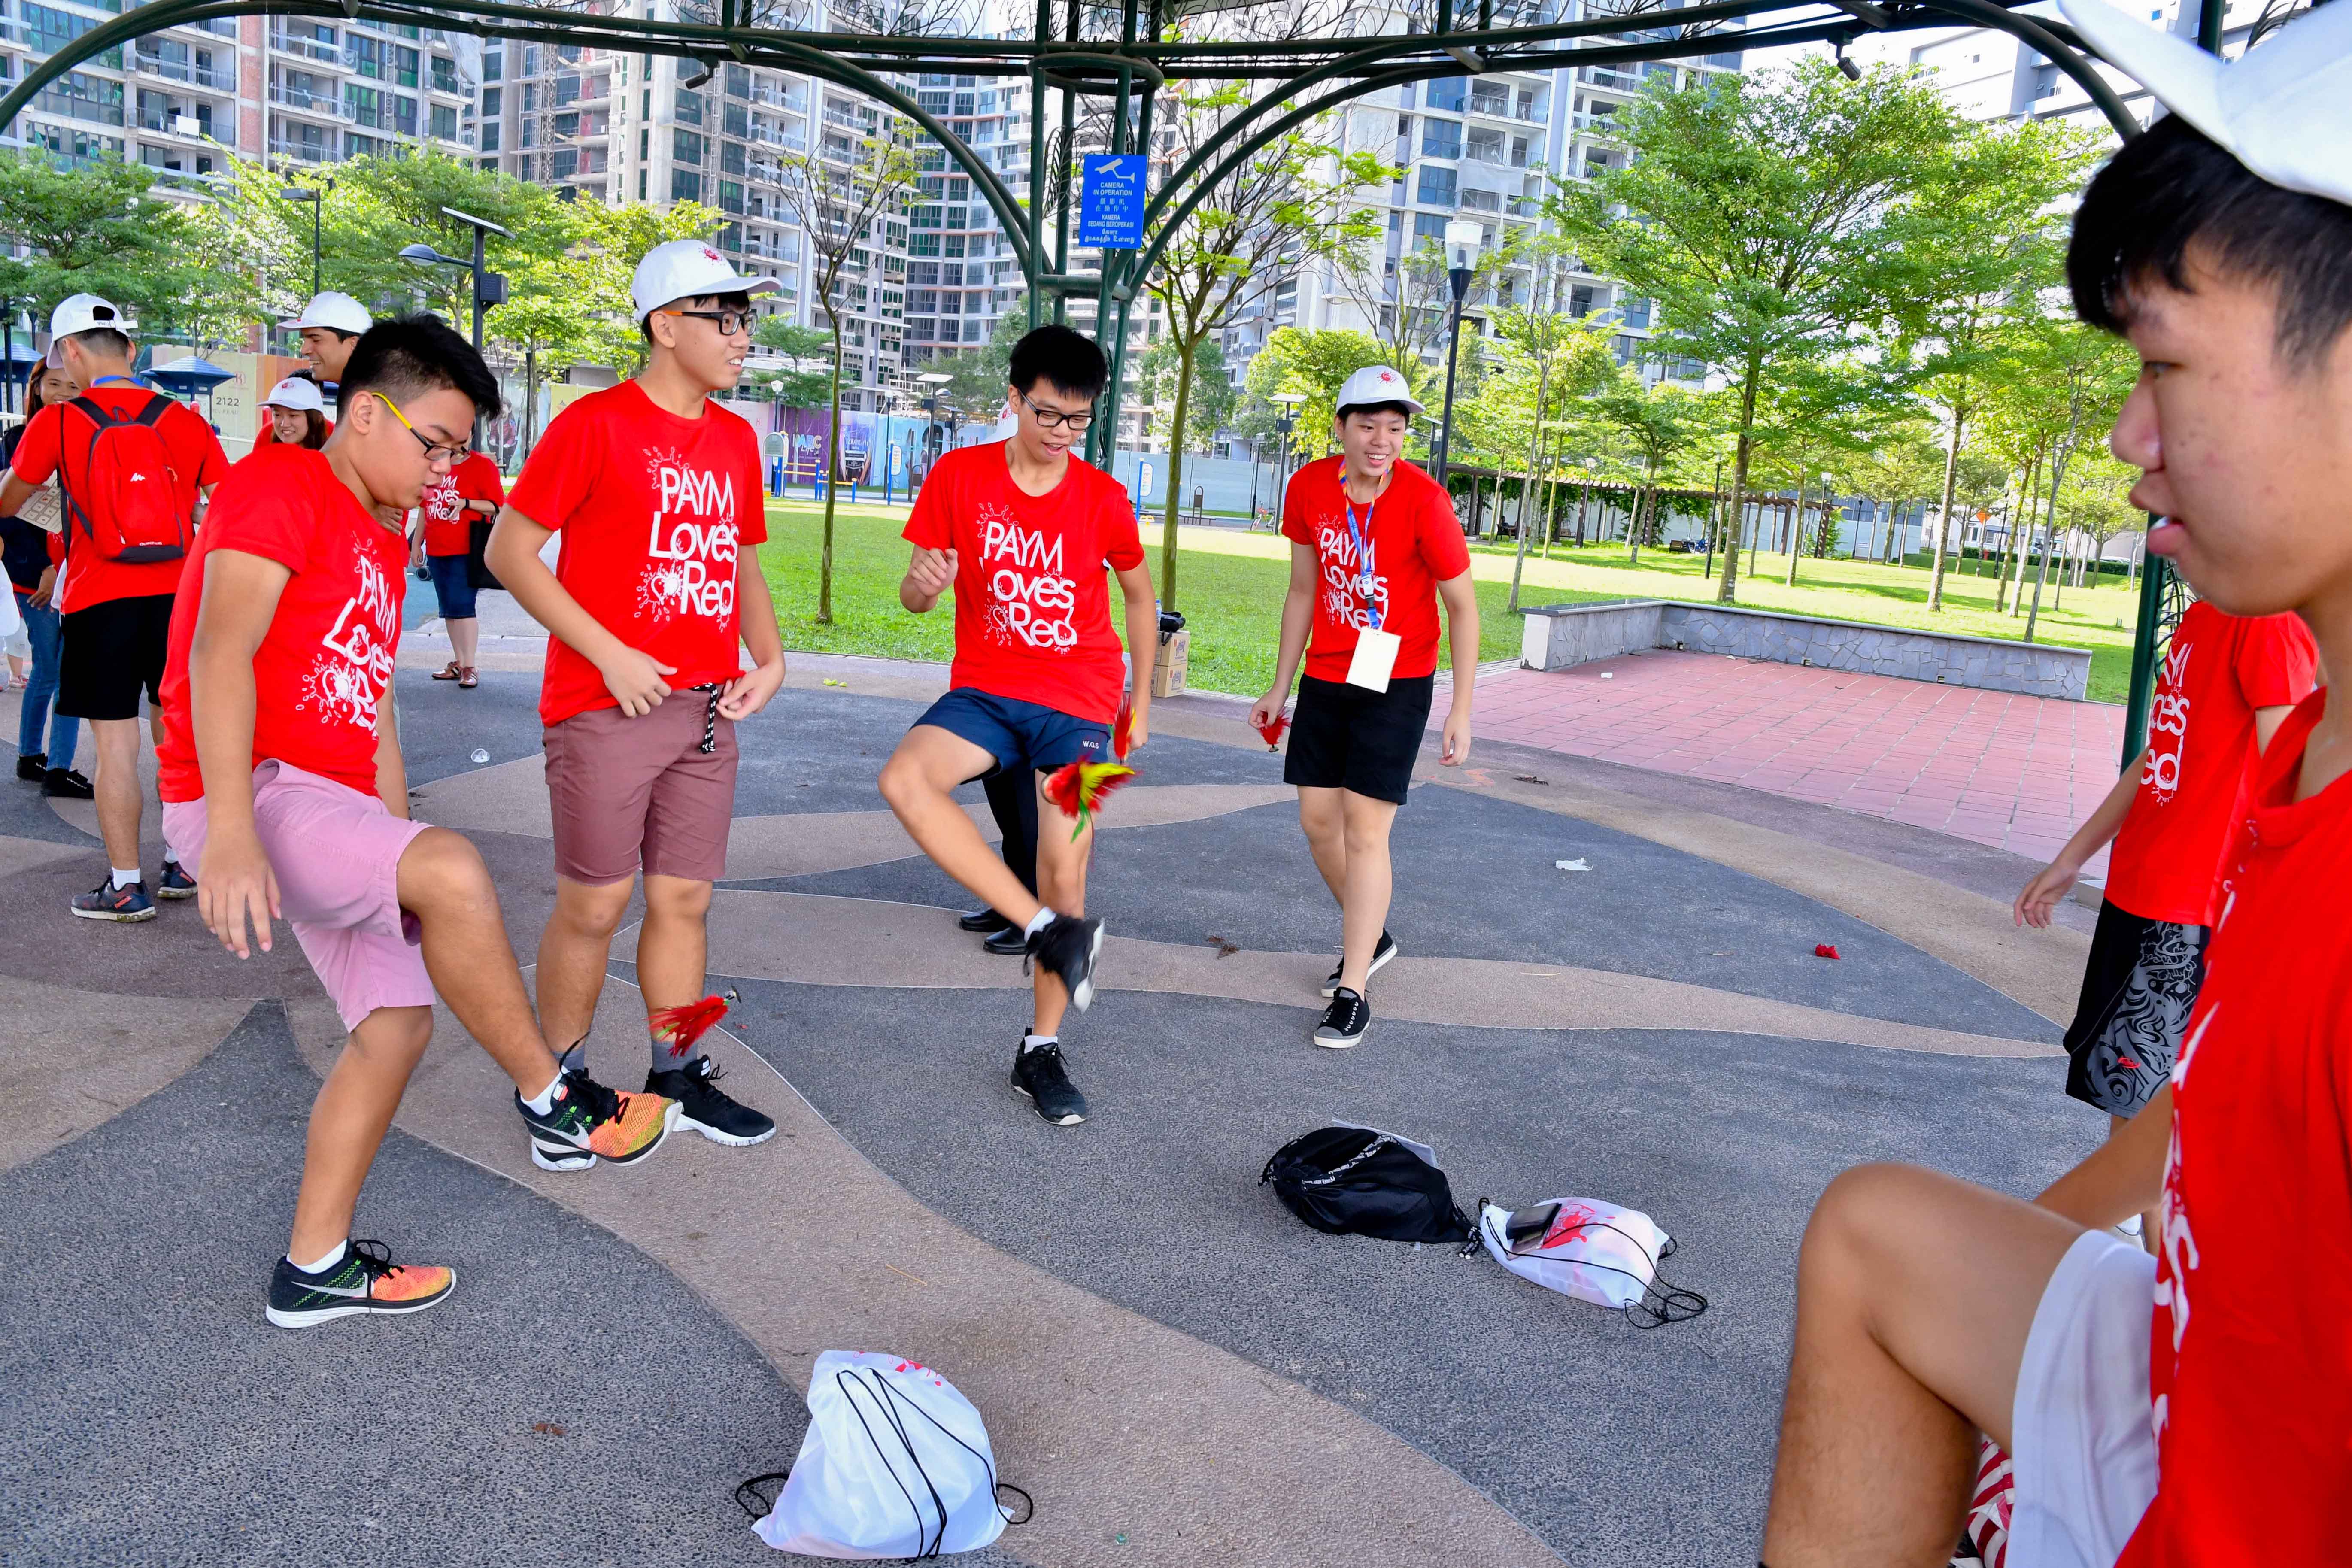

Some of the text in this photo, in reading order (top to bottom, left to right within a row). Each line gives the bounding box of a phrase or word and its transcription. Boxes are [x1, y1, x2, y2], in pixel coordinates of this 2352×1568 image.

[216, 397, 240, 407] 2122
[659, 466, 735, 518] PAYM
[983, 521, 1063, 572] PAYM
[1320, 528, 1375, 571] PAYM
[680, 560, 738, 617] Red
[1009, 601, 1077, 647] Red
